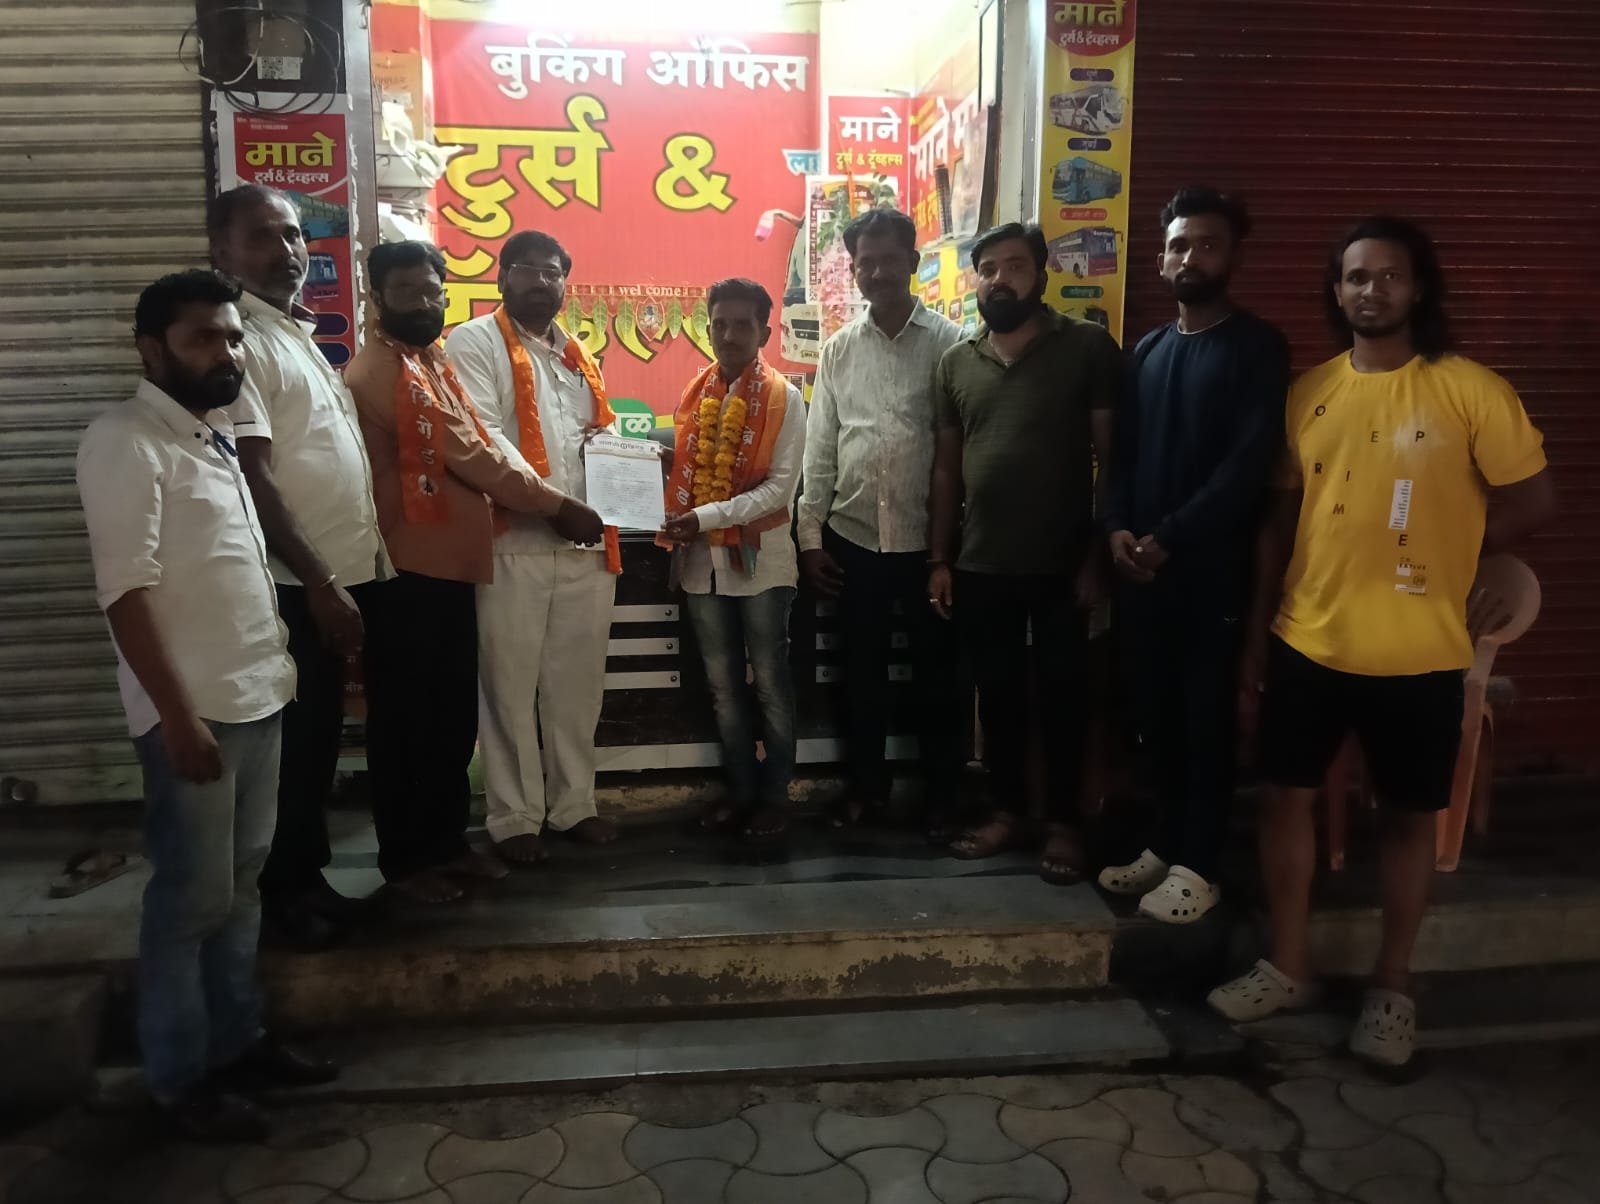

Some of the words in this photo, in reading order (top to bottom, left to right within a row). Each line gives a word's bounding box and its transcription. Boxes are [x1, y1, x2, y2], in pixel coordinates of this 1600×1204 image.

[485, 32, 626, 99] बुकिंग
[839, 105, 902, 143] माने
[243, 131, 337, 167] माने
[654, 133, 736, 213] &
[1314, 405, 1327, 417] O
[1370, 431, 1379, 443] E
[1415, 431, 1425, 442] P
[1314, 463, 1323, 474] R
[1332, 503, 1345, 515] M
[1398, 534, 1408, 546] E
